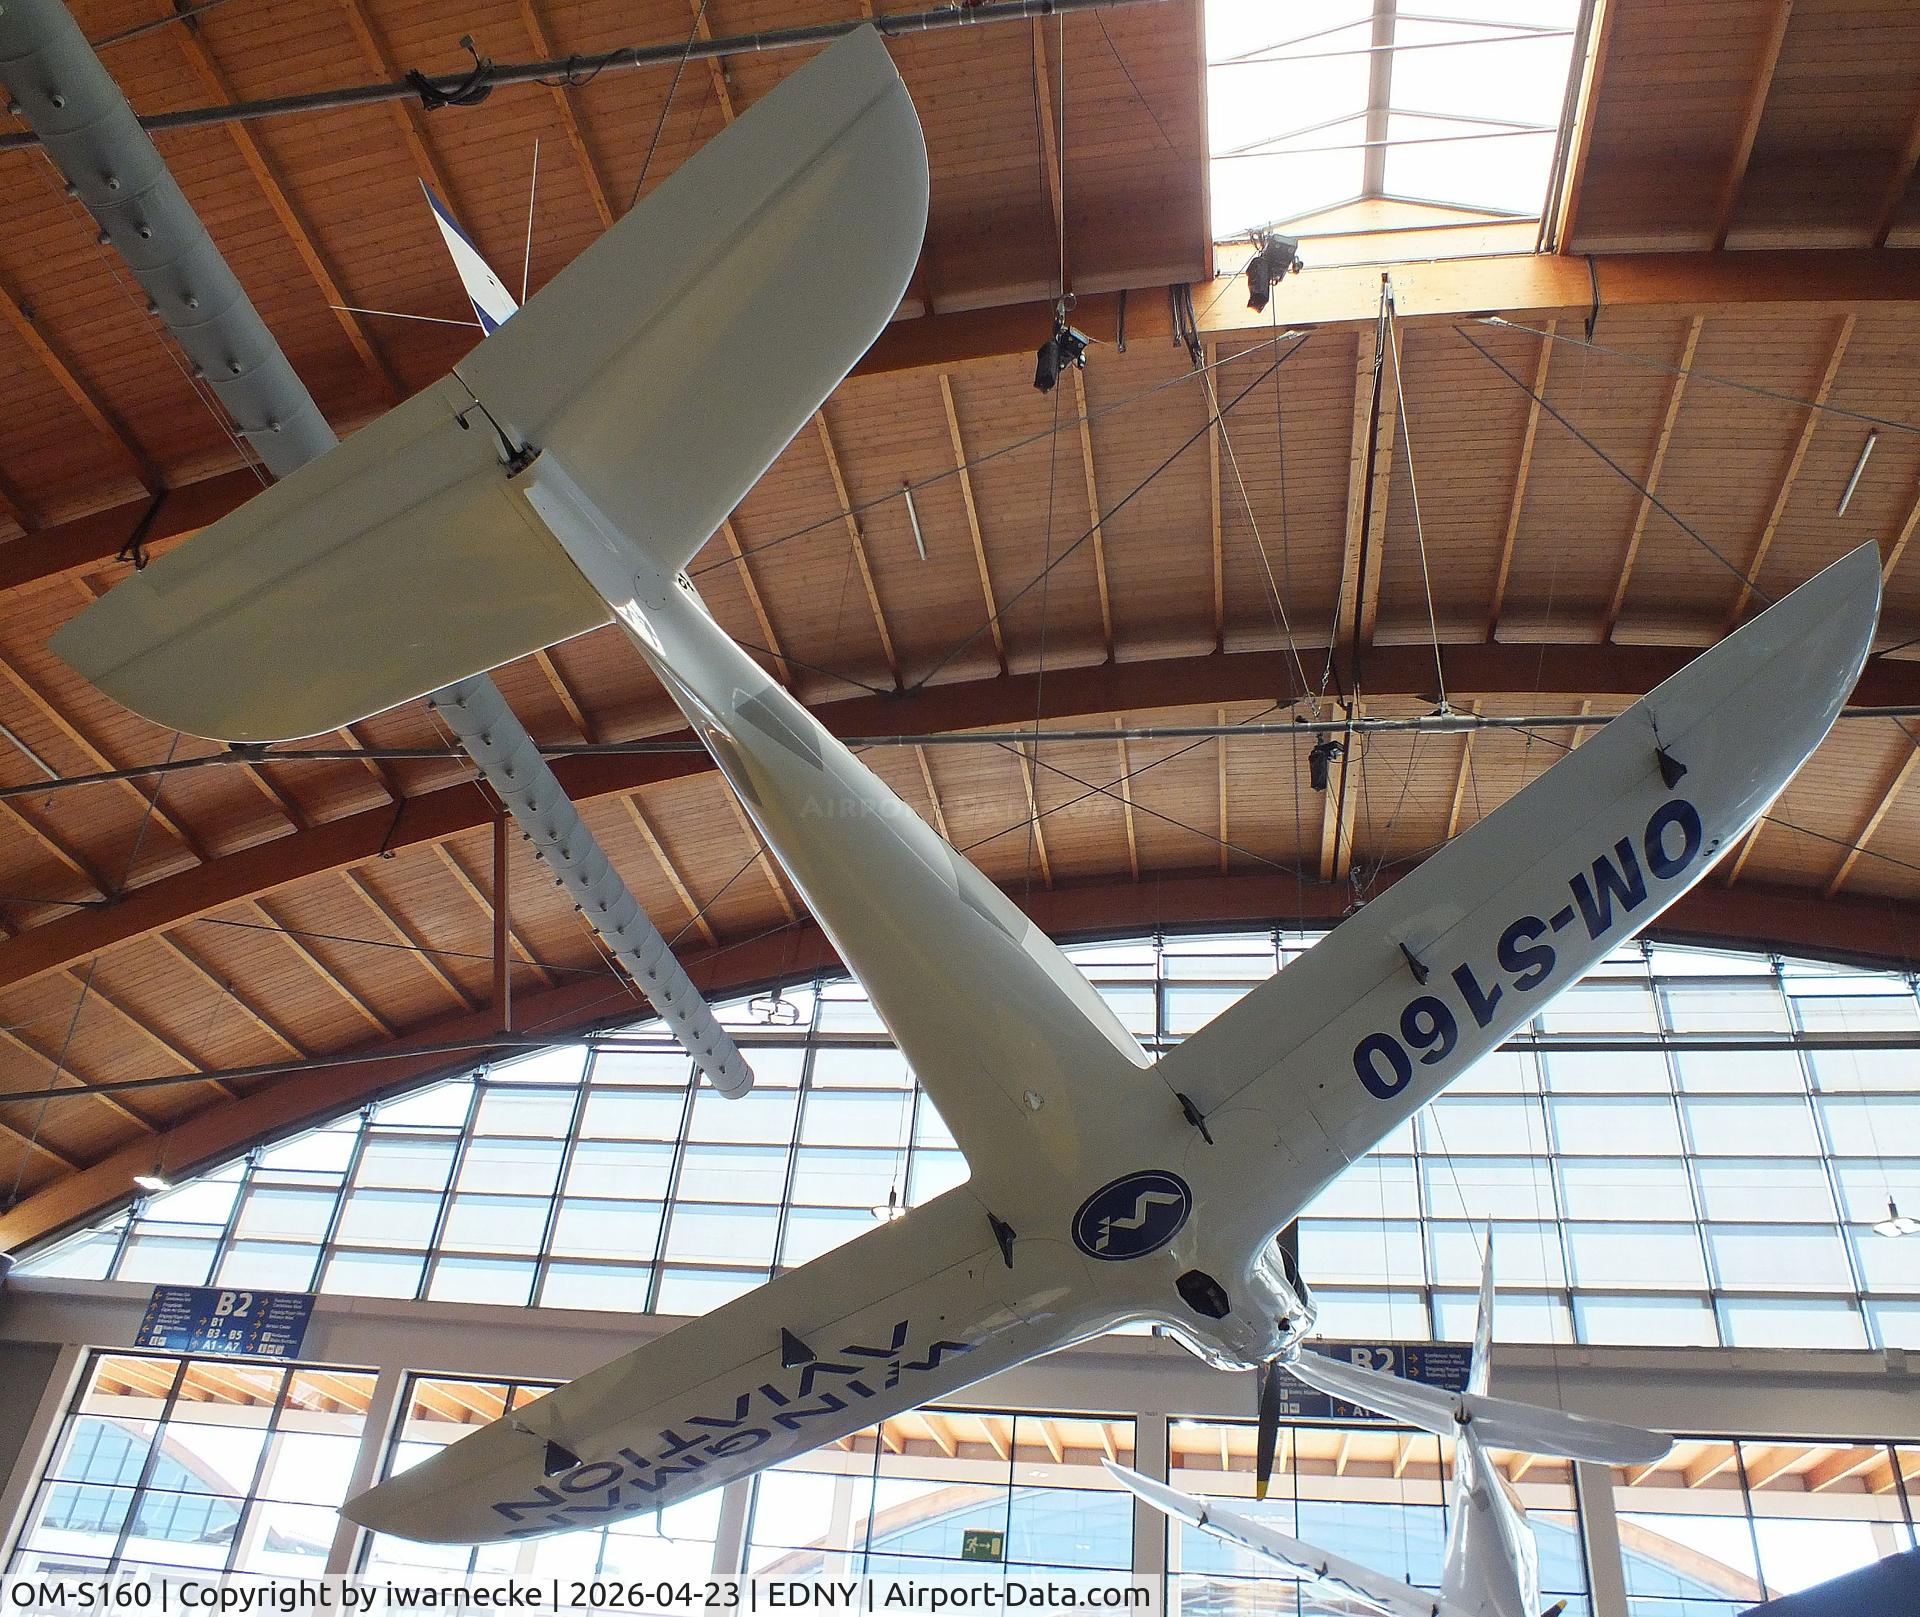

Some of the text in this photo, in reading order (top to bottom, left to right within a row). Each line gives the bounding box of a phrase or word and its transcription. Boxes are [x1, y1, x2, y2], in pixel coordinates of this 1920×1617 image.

[1353, 799, 1702, 1100] OM-S160
[214, 1291, 253, 1318] B2
[206, 1328, 220, 1339] B3
[210, 1318, 224, 1327] B1
[202, 1340, 217, 1350] A1
[224, 1342, 239, 1352] A7
[1351, 1348, 1395, 1375] B2
[492, 1320, 909, 1522] AVIATION
[503, 1339, 975, 1539] WINGMAN
